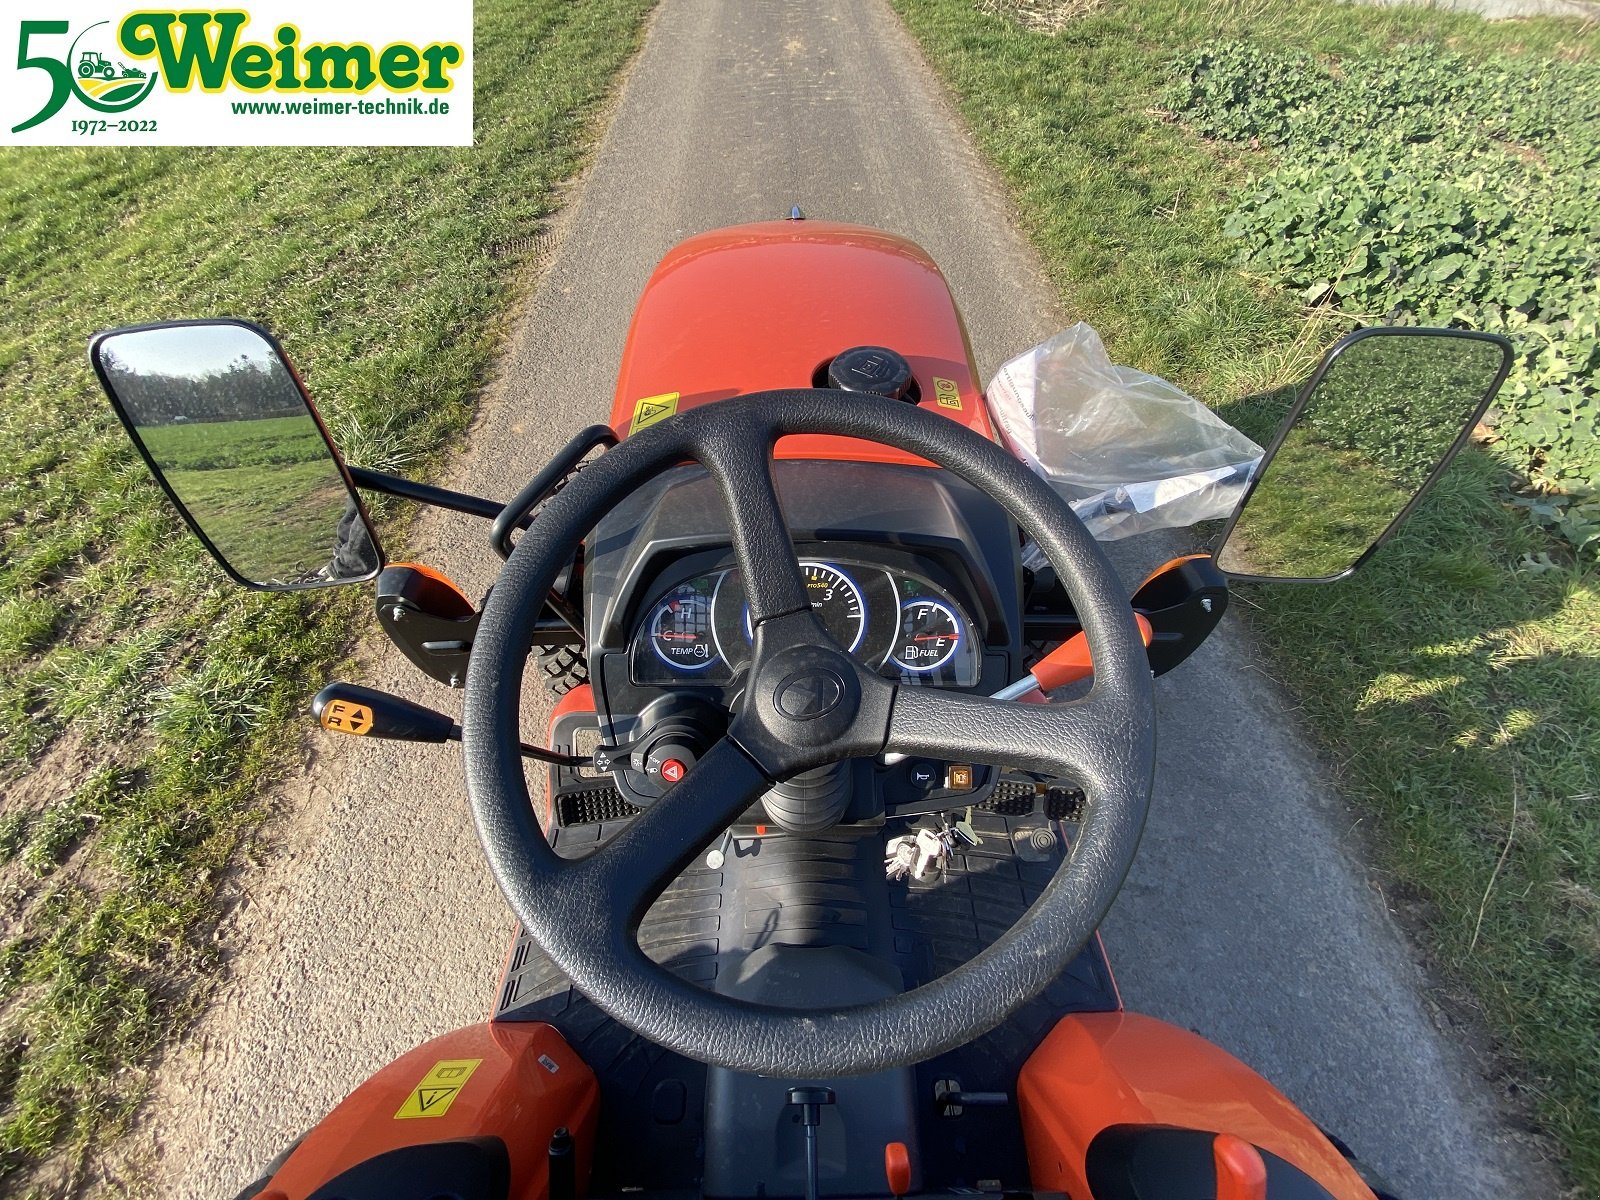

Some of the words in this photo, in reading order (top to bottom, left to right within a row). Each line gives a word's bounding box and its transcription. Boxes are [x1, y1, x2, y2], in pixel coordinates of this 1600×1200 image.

[823, 588, 834, 601] 3
[680, 607, 692, 619] H
[917, 608, 929, 620] F
[935, 636, 946, 647] E
[670, 647, 694, 656] TEMP
[919, 649, 939, 657] FUEL
[332, 704, 346, 714] F
[327, 716, 342, 727] R
